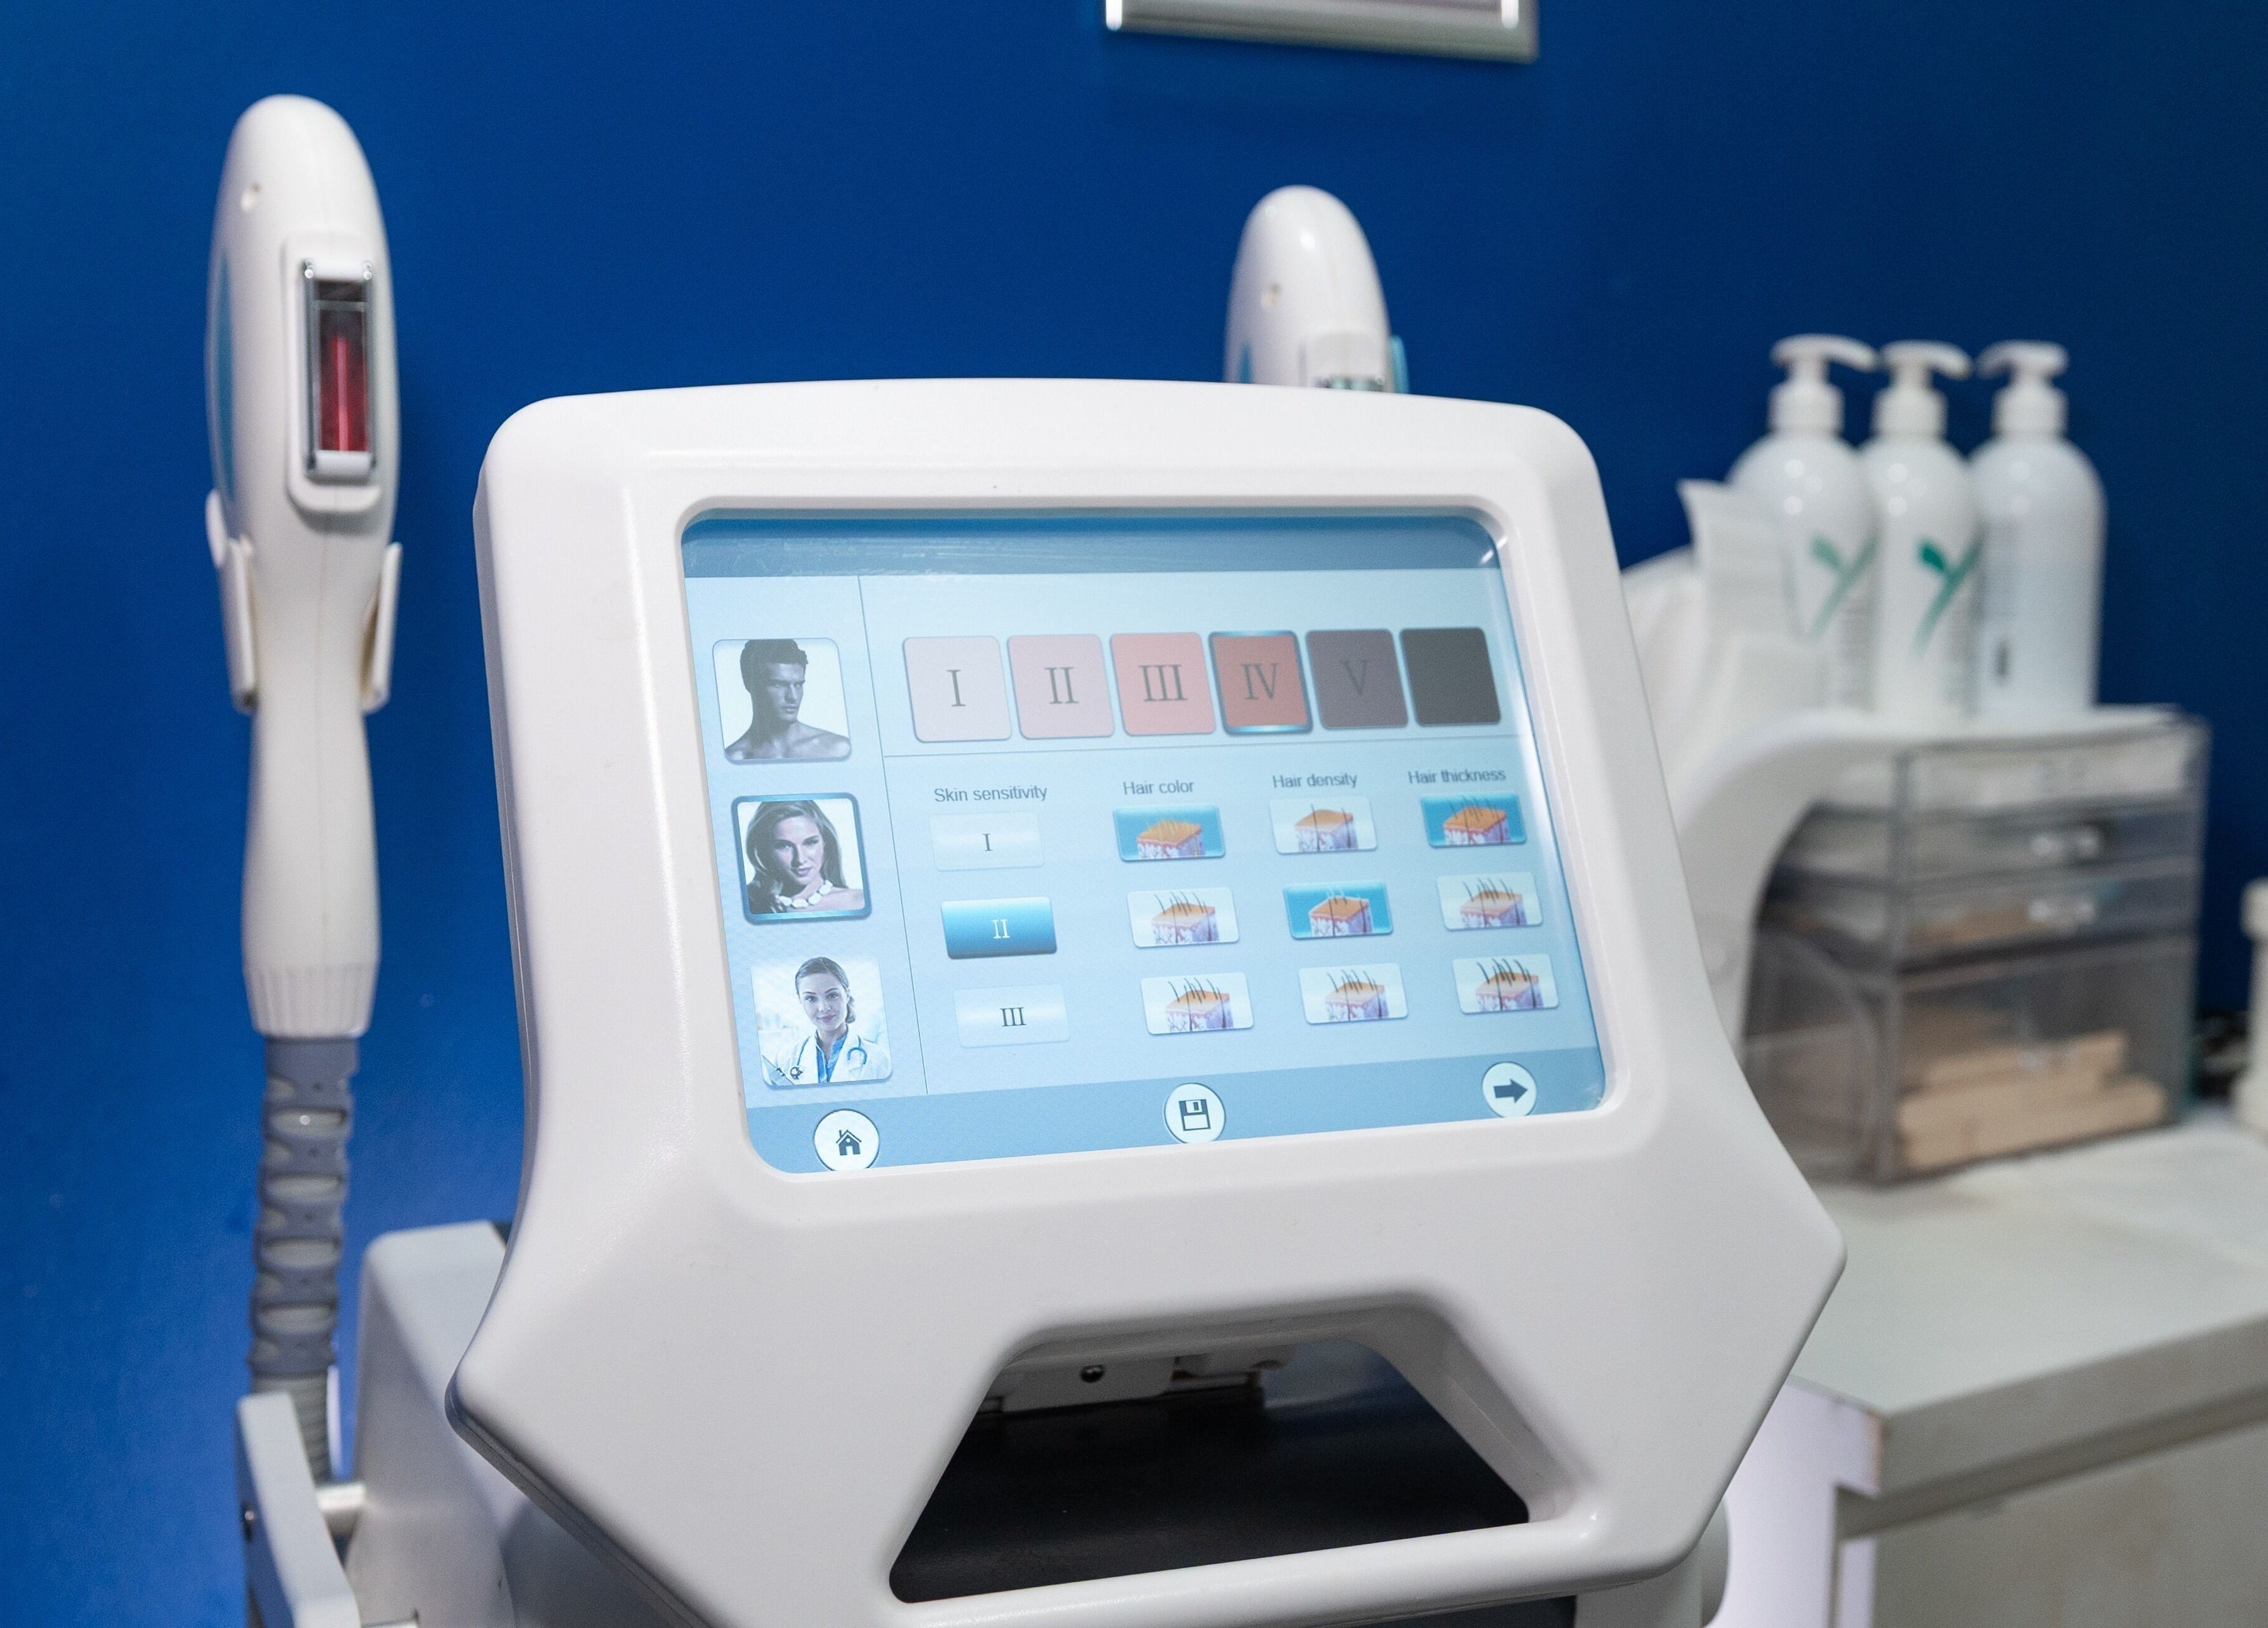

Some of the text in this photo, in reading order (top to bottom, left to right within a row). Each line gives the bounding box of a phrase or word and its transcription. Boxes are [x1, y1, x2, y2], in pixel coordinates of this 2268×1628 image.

[947, 669, 966, 707] I
[1044, 666, 1079, 705] II
[1138, 664, 1188, 702] III
[1240, 663, 1278, 700] IV
[1342, 659, 1371, 697] V
[1272, 773, 1358, 788] Hair density
[1408, 768, 1506, 784] Hair thickness
[934, 785, 1048, 803] Skin sensitivity
[1123, 779, 1195, 795] Hair color
[982, 833, 993, 852] I
[992, 919, 1011, 939] II
[1000, 1007, 1027, 1027] III
